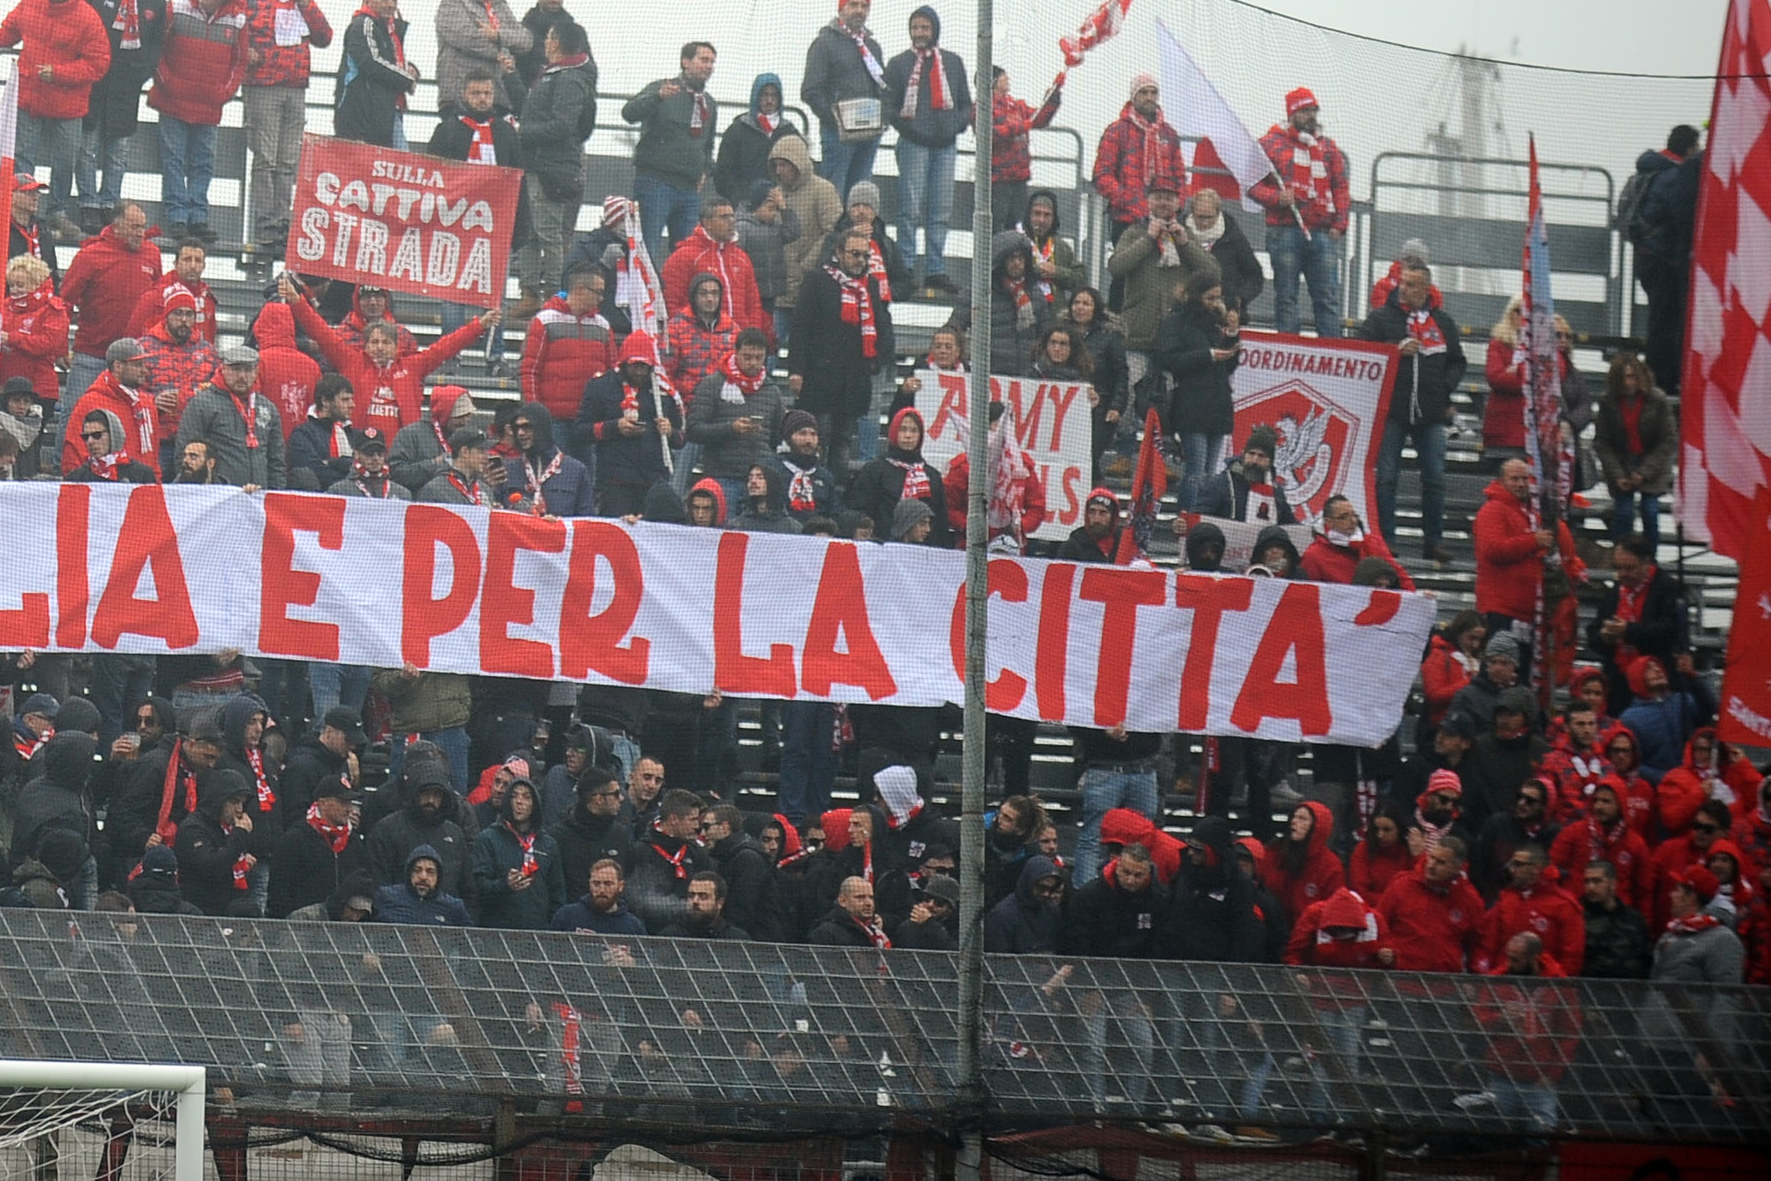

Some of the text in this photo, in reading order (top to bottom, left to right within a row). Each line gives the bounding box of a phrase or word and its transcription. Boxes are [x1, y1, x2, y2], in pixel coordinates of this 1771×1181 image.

[315, 171, 494, 234] CATTIVA
[371, 160, 445, 189] SULLA
[296, 206, 492, 295] STRADA
[258, 492, 347, 662] E
[401, 504, 651, 686] PER
[712, 530, 898, 701] LA
